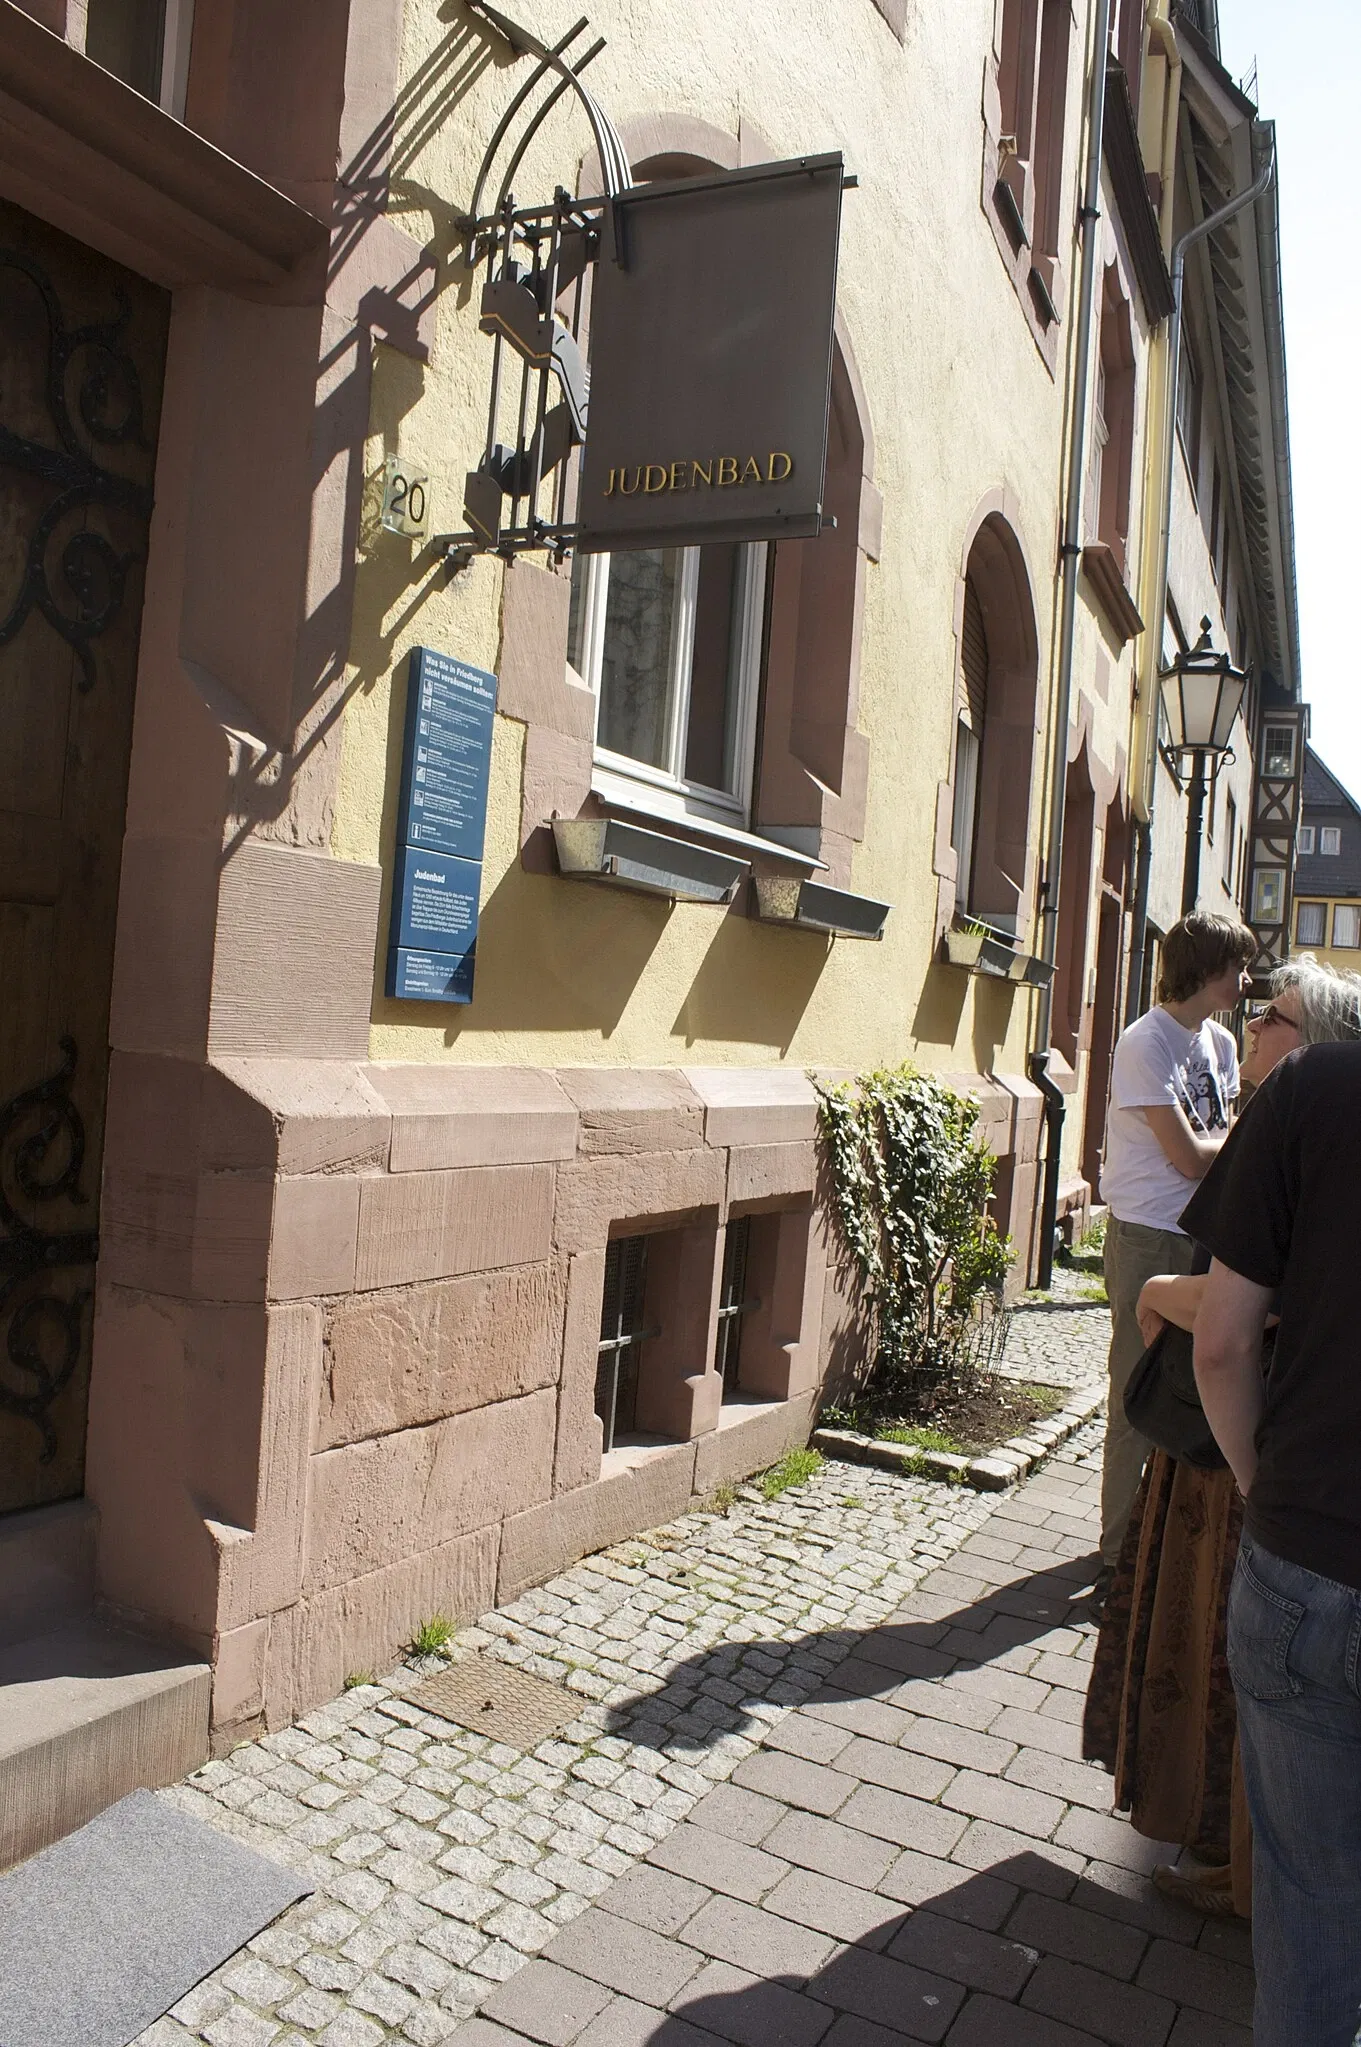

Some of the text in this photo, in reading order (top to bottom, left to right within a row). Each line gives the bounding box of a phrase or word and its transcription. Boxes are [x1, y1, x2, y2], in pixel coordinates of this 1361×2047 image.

[603, 452, 793, 496] JUDENBAD
[389, 474, 425, 523] 20
[424, 667, 440, 679] nicht
[425, 655, 484, 686] Was Sie in Friedberg
[414, 869, 446, 883] Judenbad
